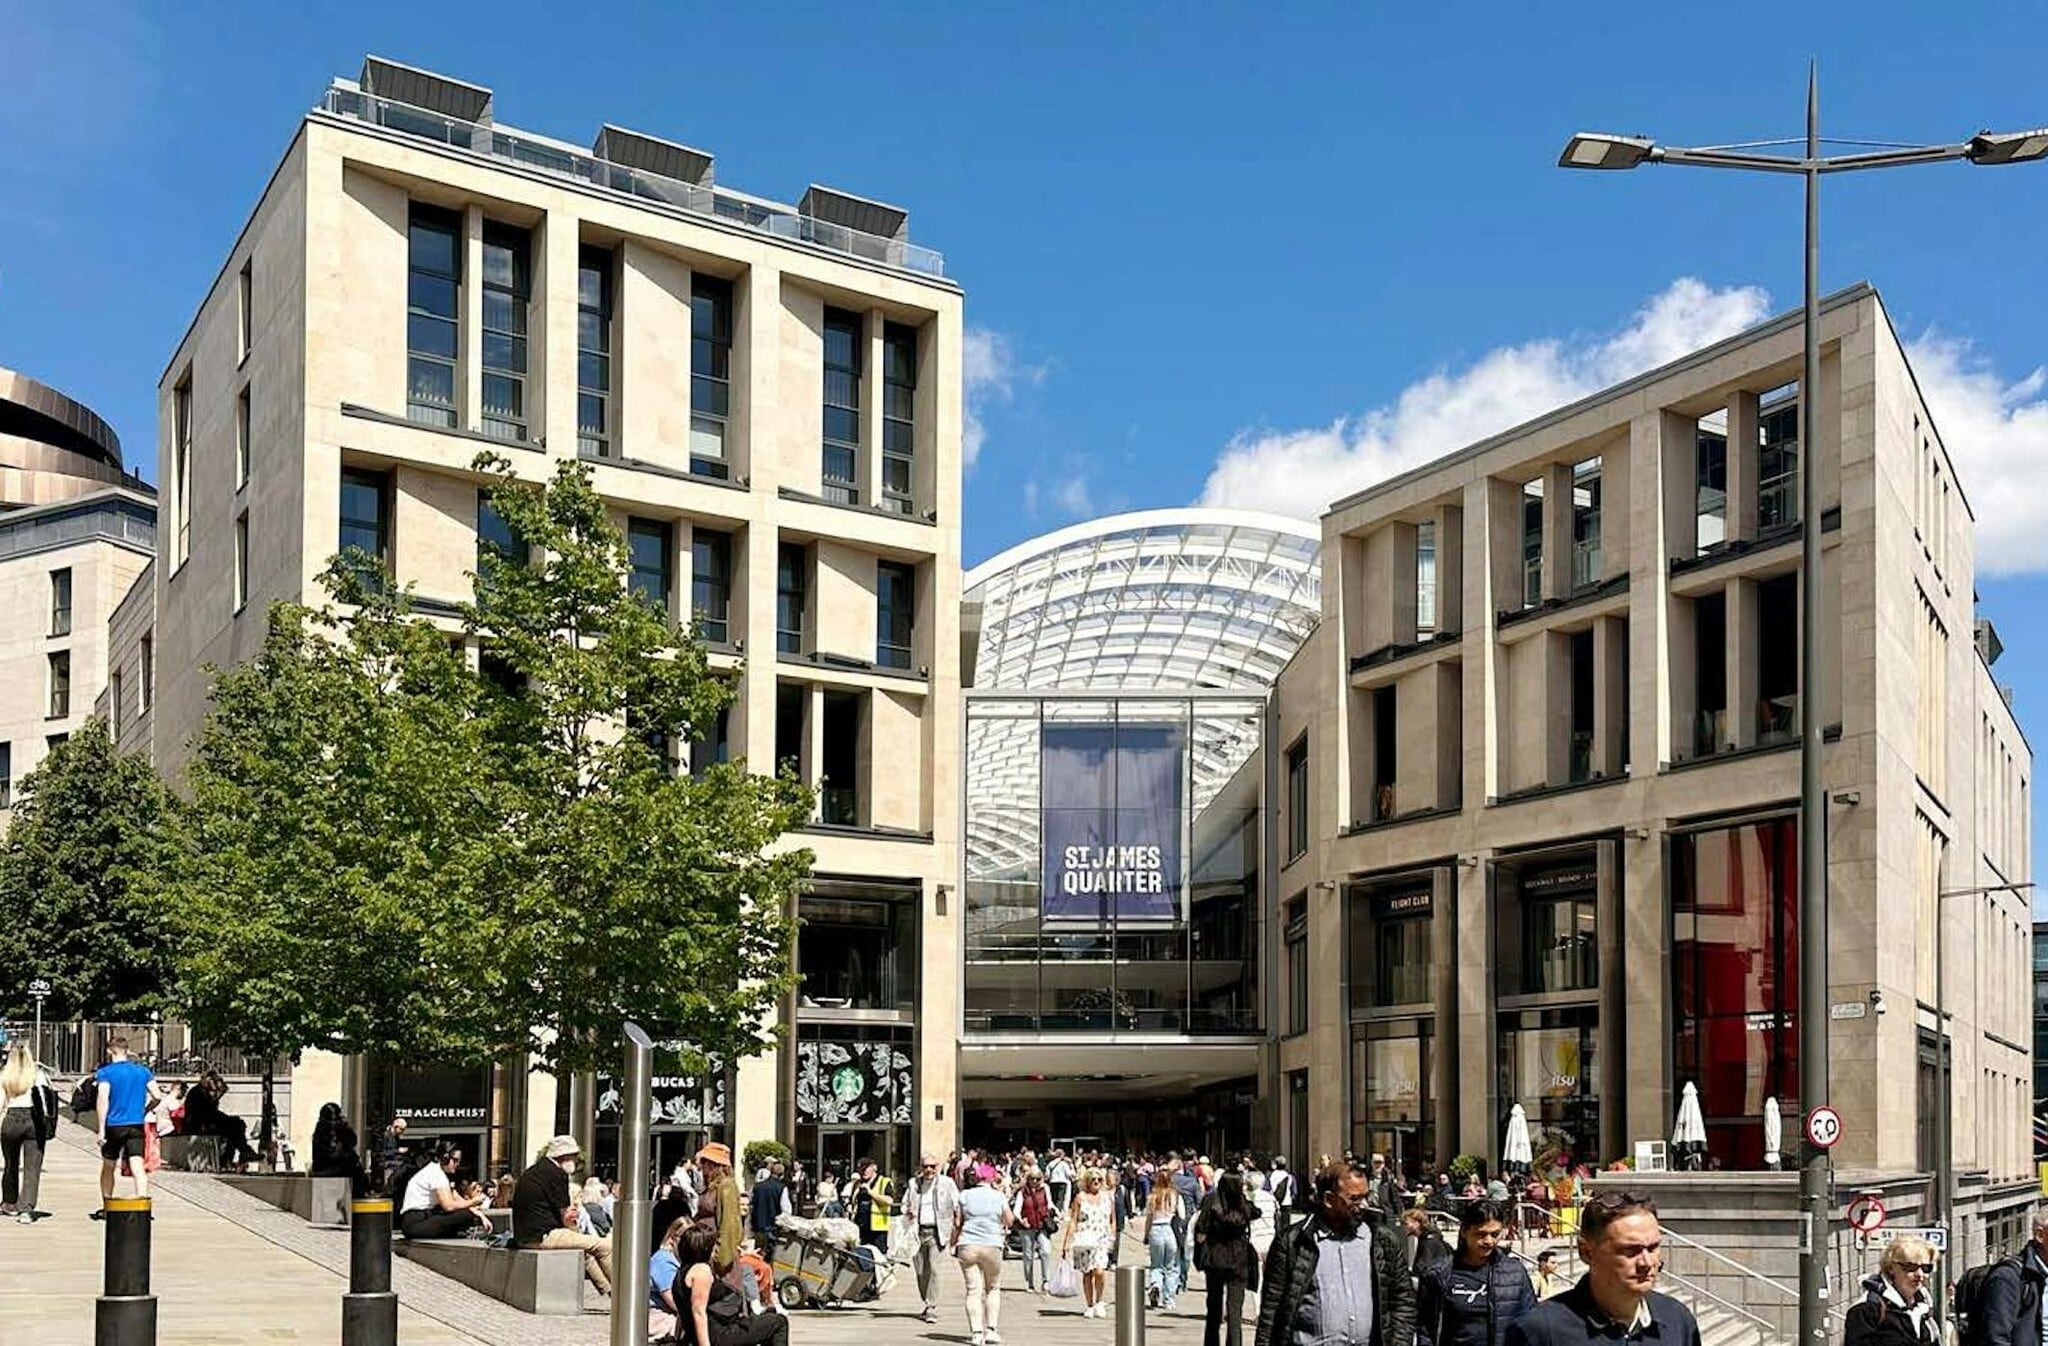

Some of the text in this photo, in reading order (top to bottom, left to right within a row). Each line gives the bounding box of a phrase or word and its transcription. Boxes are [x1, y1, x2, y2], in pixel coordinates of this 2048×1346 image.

[1064, 846, 1161, 869] ST JAMES
[1064, 870, 1162, 895] QUARTER
[413, 1107, 486, 1118] ALCHEMIST
